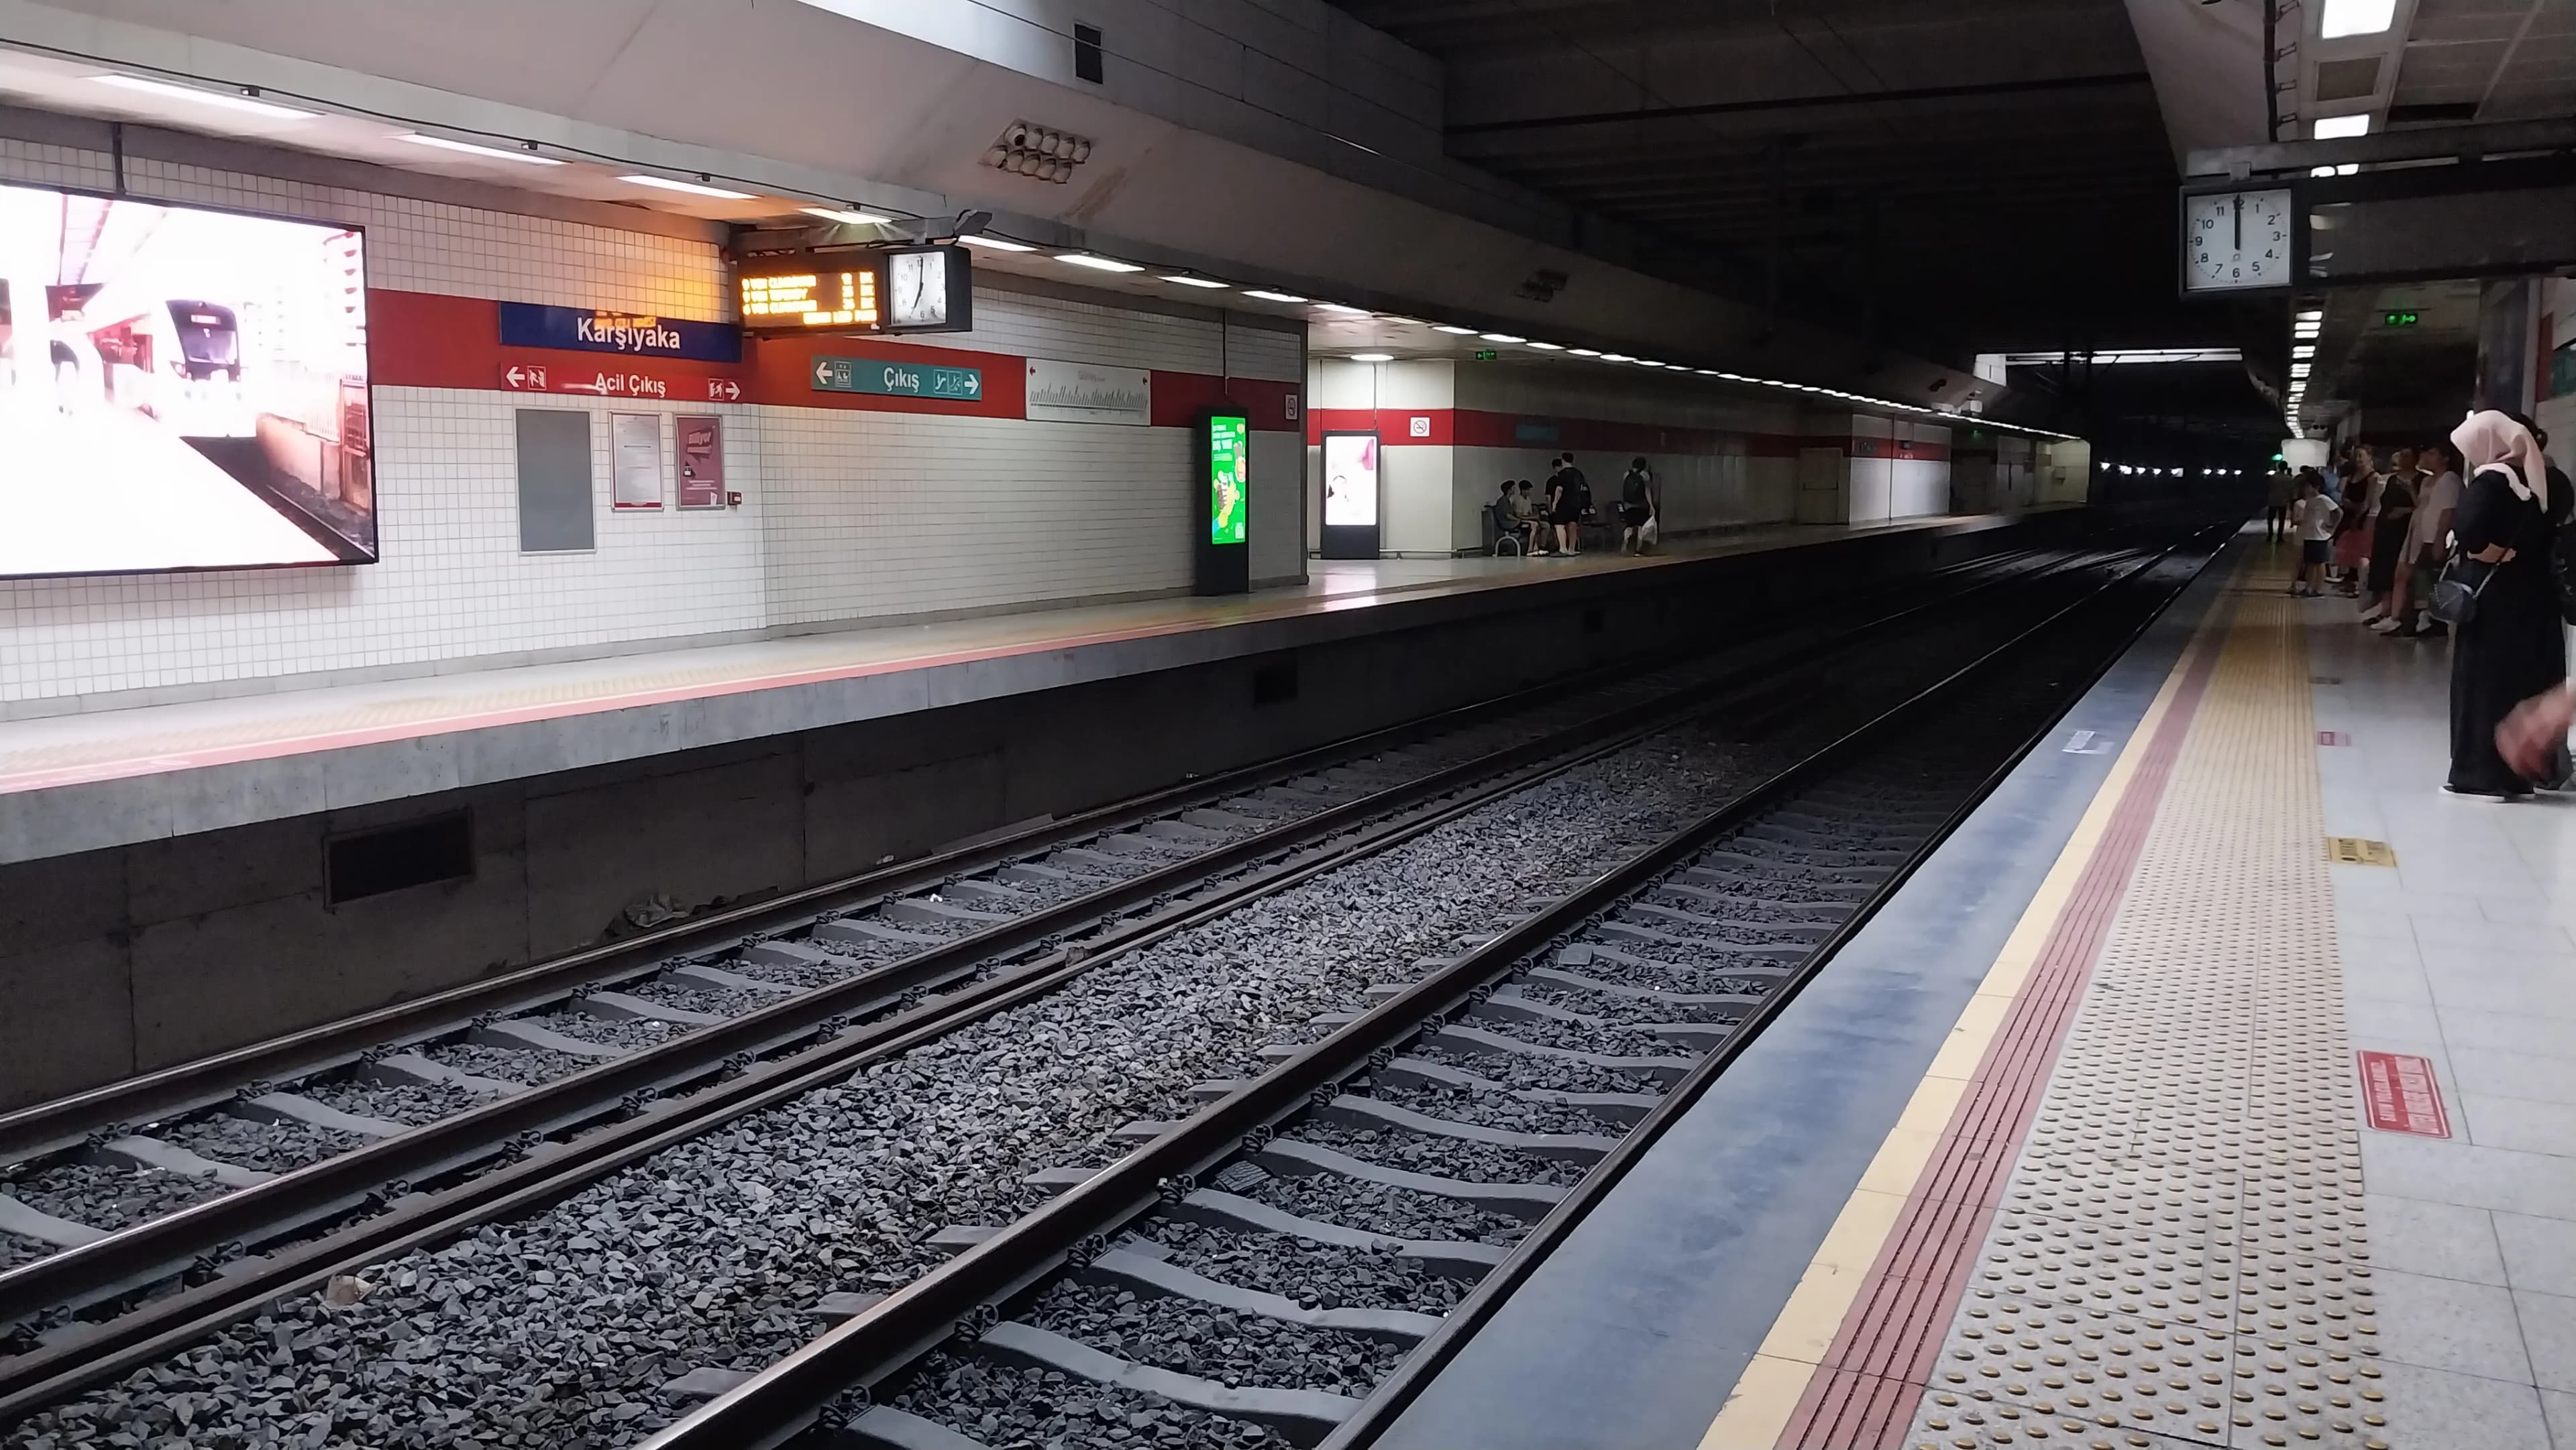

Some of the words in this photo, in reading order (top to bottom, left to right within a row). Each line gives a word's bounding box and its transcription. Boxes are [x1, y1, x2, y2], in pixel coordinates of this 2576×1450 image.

[2216, 207, 2224, 216] 11
[2255, 204, 2259, 213] 1
[2202, 219, 2214, 229] 10
[2267, 215, 2276, 225] 2
[2195, 236, 2203, 246] 9
[2273, 231, 2280, 241] 3
[2200, 253, 2208, 263] 8
[2265, 249, 2273, 258] 4
[2214, 264, 2223, 274] 7
[2252, 262, 2260, 272] 5
[2233, 268, 2240, 278] 6
[920, 310, 924, 318] 6
[577, 317, 681, 352] Karşıyaka
[883, 366, 920, 393] Çıkış
[595, 372, 625, 392] Acil
[629, 374, 666, 398] Çıkış
